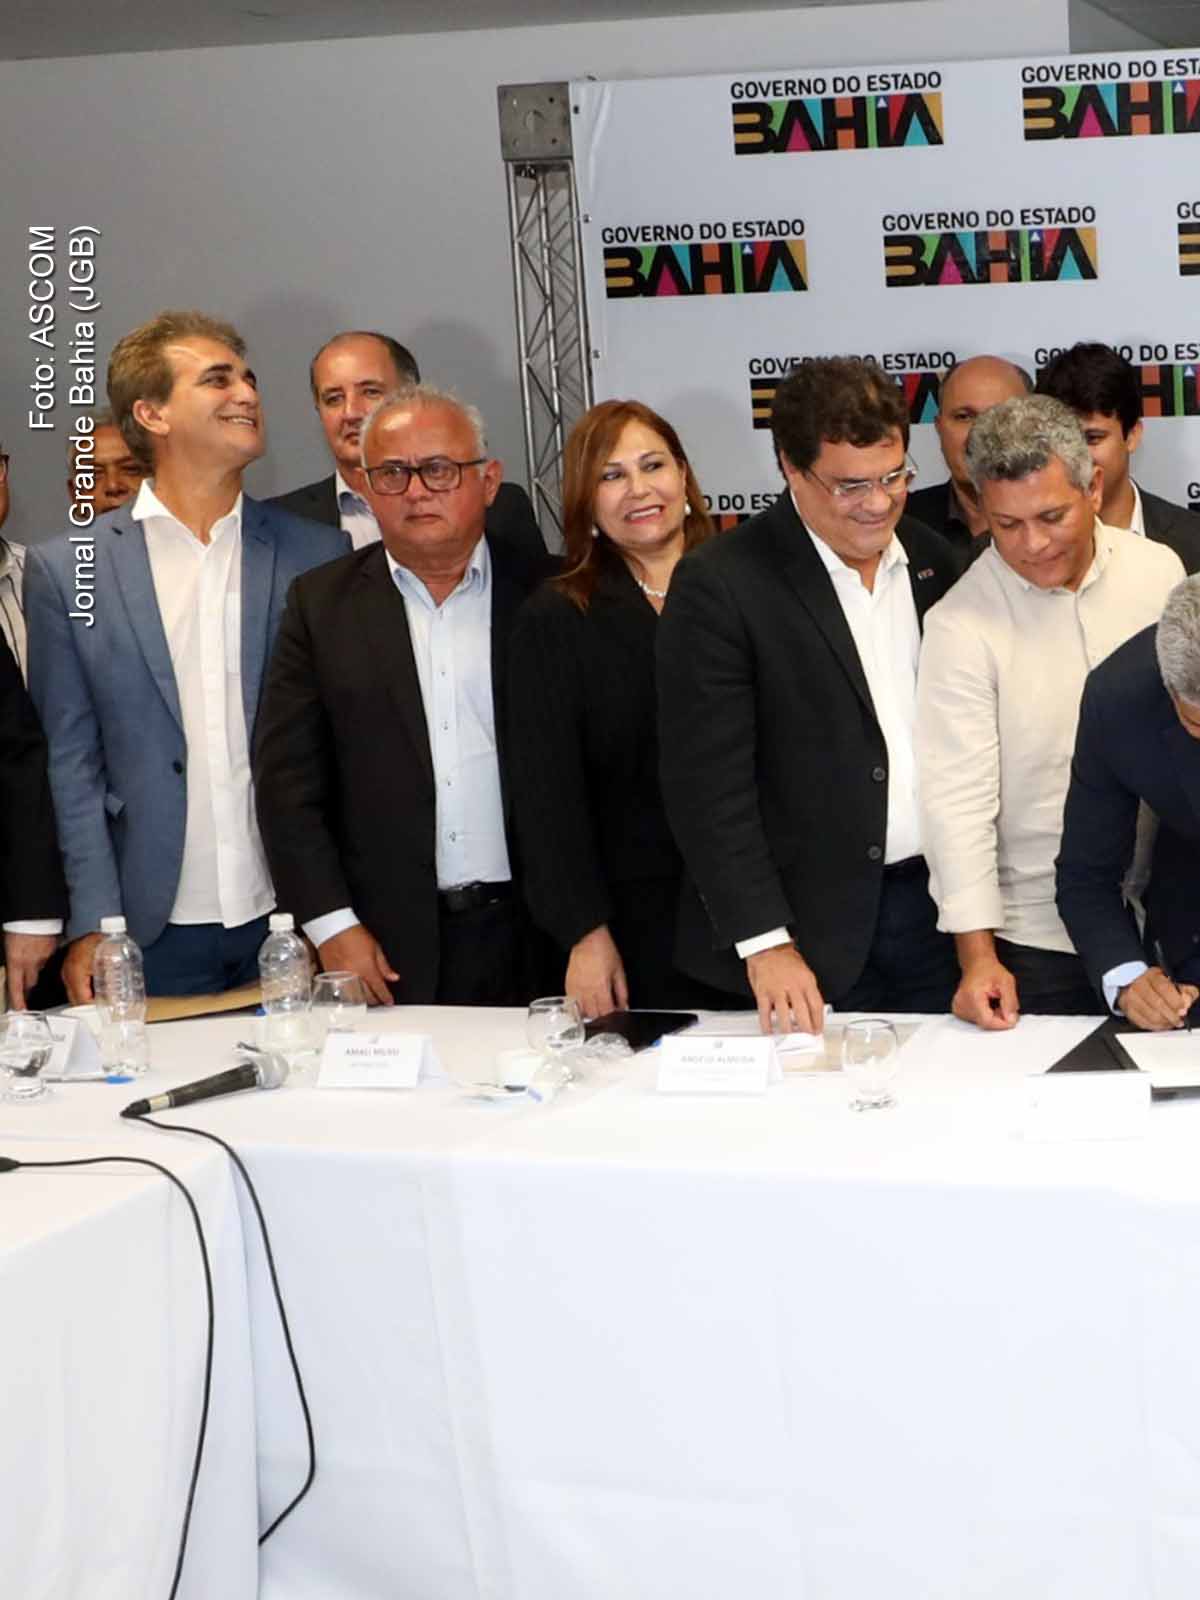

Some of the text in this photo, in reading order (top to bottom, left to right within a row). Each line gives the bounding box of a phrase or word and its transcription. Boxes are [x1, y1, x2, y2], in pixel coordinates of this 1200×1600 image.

[1021, 62, 1122, 84] GOVERNO
[1128, 60, 1157, 78] DO
[730, 71, 942, 99] GOVERNO DO ESTADO
[731, 92, 944, 156] BAHIA
[601, 219, 805, 244] GOVERNO DO ESTADO
[882, 206, 1096, 232] GOVERNO DO ESTADO
[603, 239, 808, 299] BAHIA
[883, 226, 1098, 288] BAHIA
[882, 351, 956, 371] ESTADO
[1139, 343, 1168, 362] DO
[719, 494, 744, 511] DO
